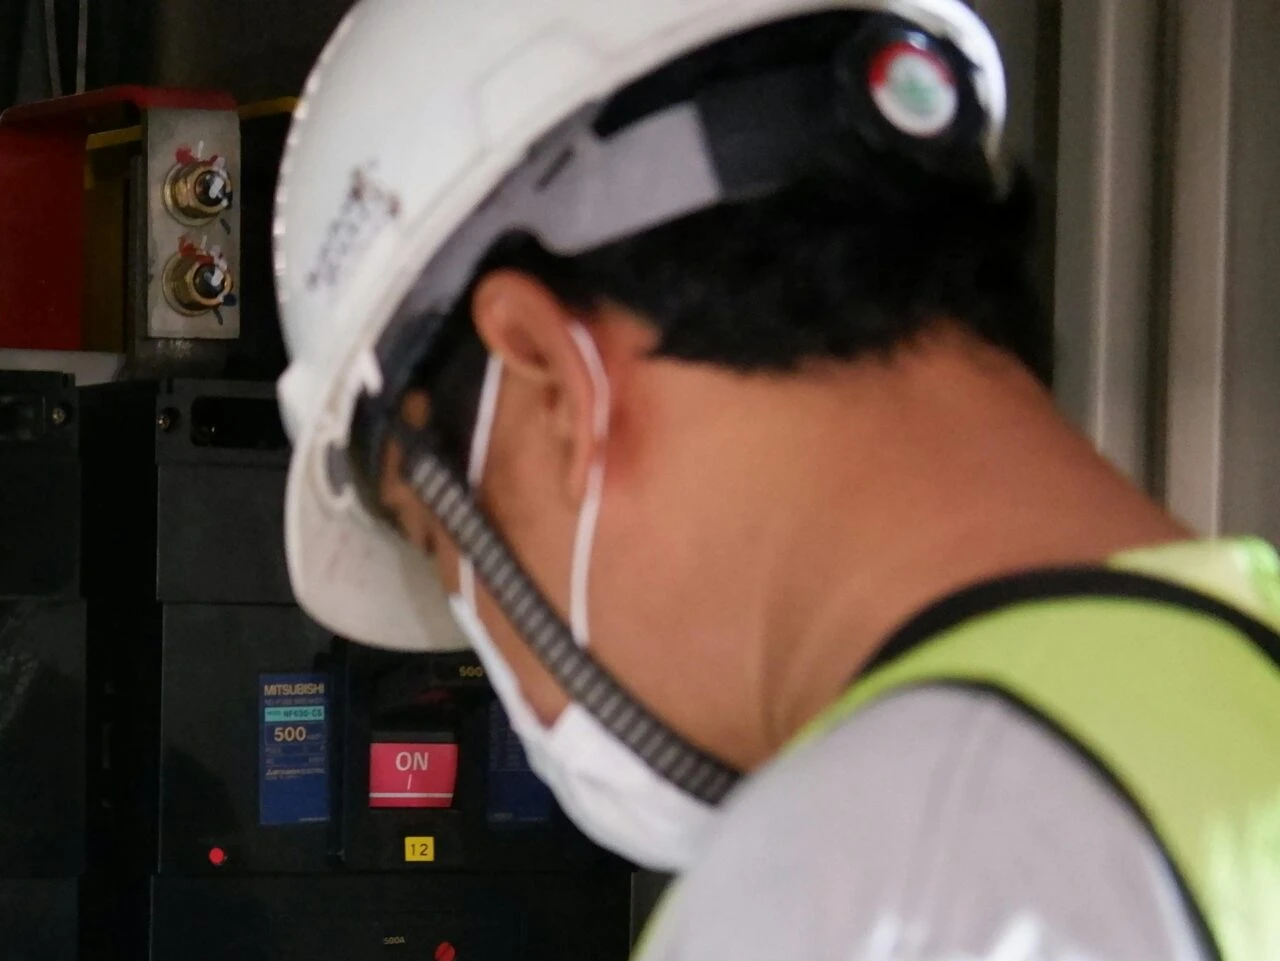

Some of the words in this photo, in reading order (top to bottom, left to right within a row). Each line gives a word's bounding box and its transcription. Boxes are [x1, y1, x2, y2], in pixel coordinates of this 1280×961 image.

[264, 682, 325, 697] MITSUBISHI
[274, 726, 307, 742] 500
[395, 751, 429, 771] ON
[411, 843, 428, 856] 12
